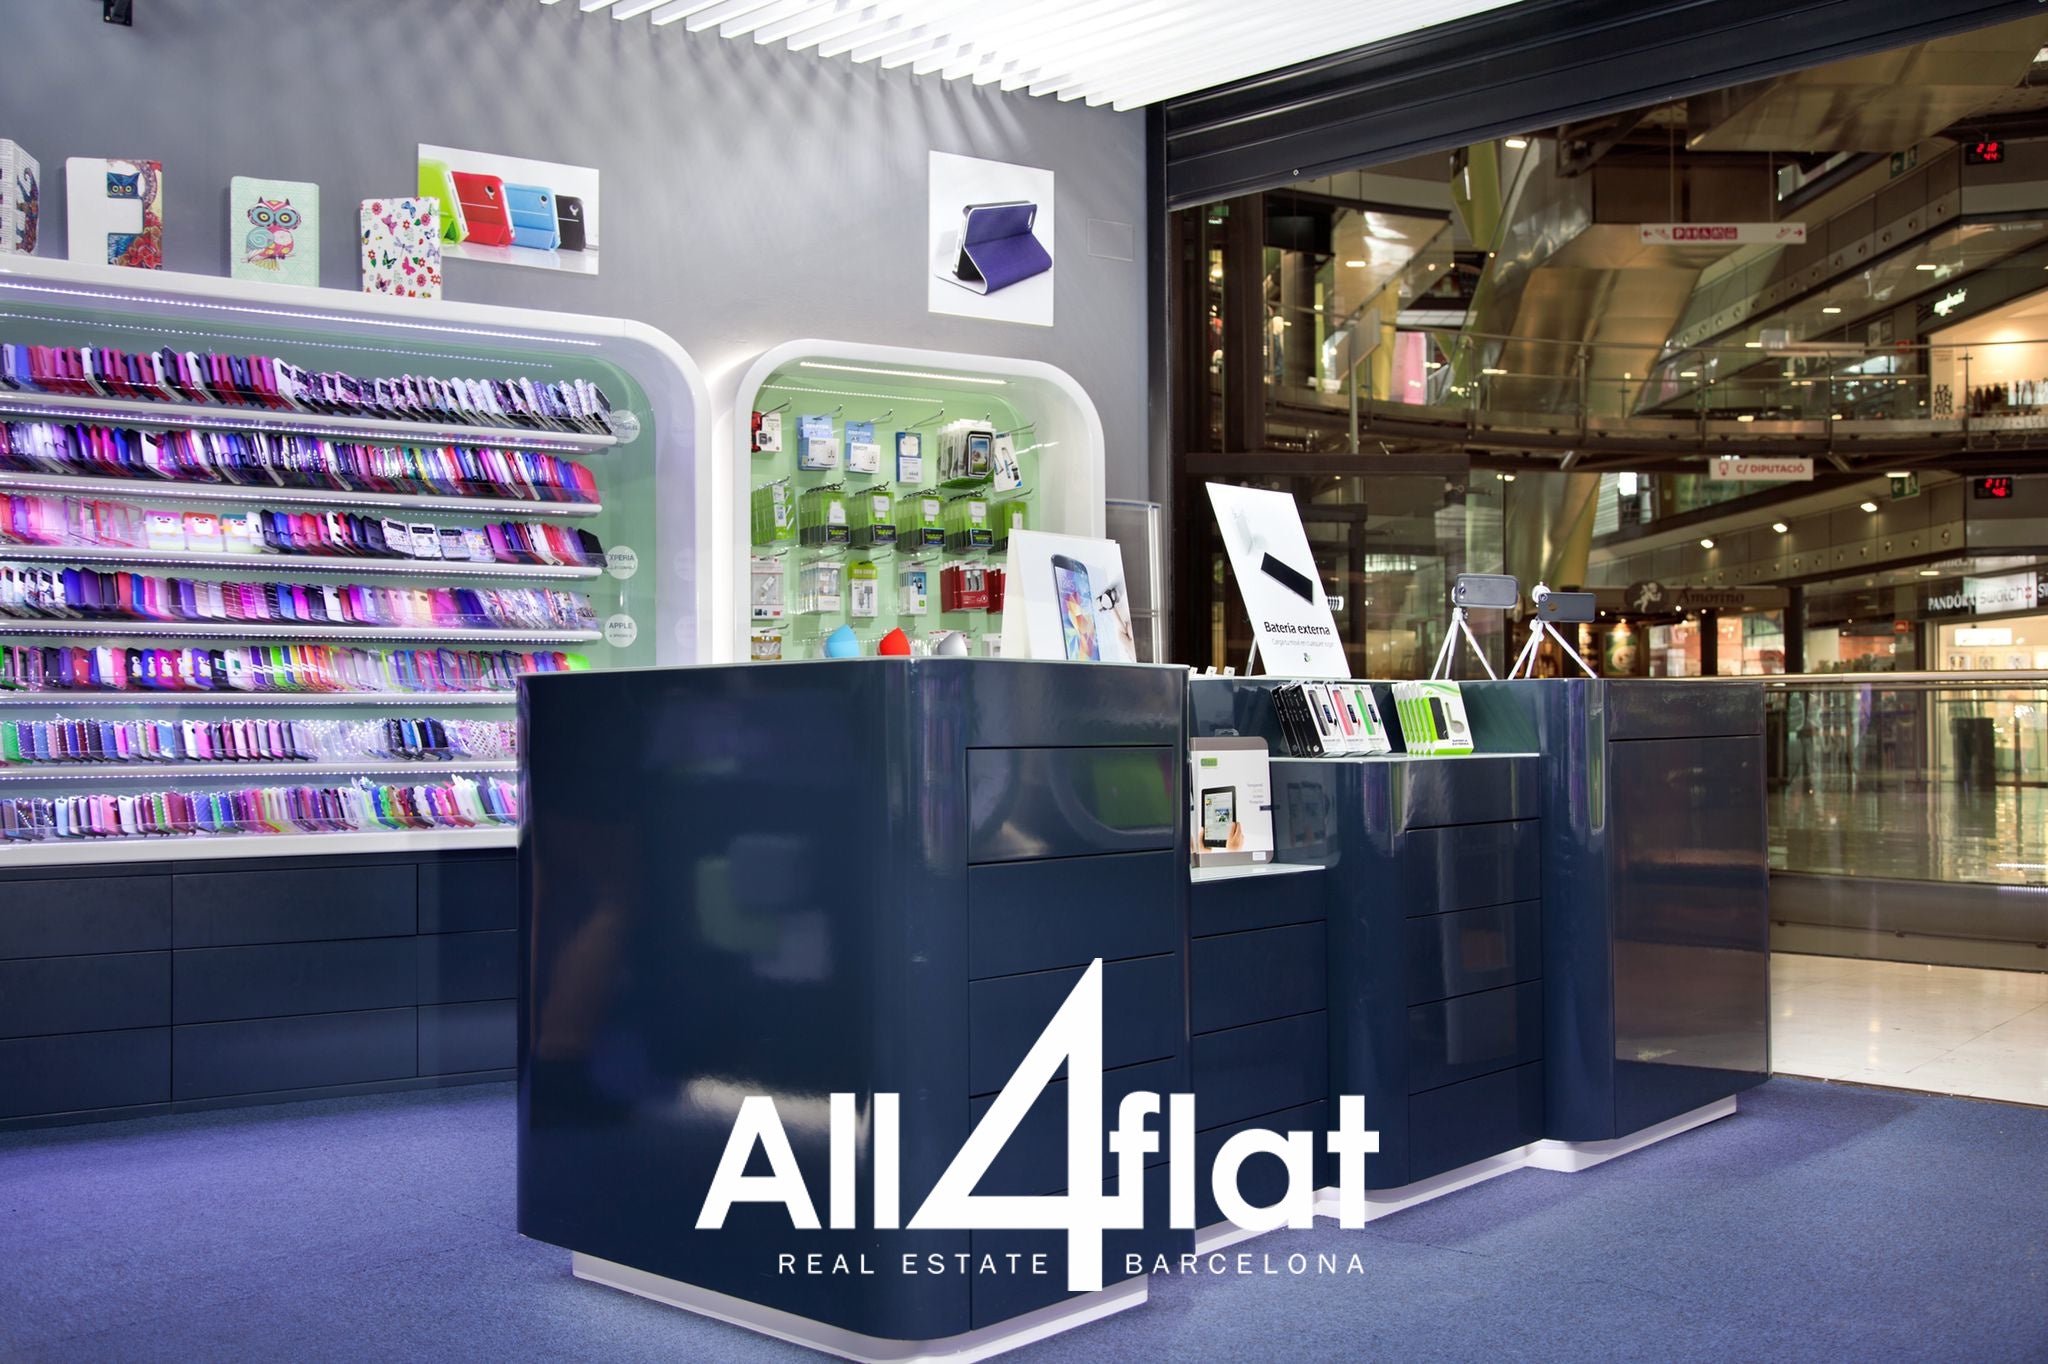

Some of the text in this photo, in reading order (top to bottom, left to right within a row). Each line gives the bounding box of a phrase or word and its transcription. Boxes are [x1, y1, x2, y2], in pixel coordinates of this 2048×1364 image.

[1736, 463, 1805, 474] C/ DIPUTACIÓ
[609, 553, 635, 562] XPERIA
[1678, 588, 1745, 604] Amorino
[609, 622, 633, 630] APPLE
[1297, 625, 1331, 635] externa
